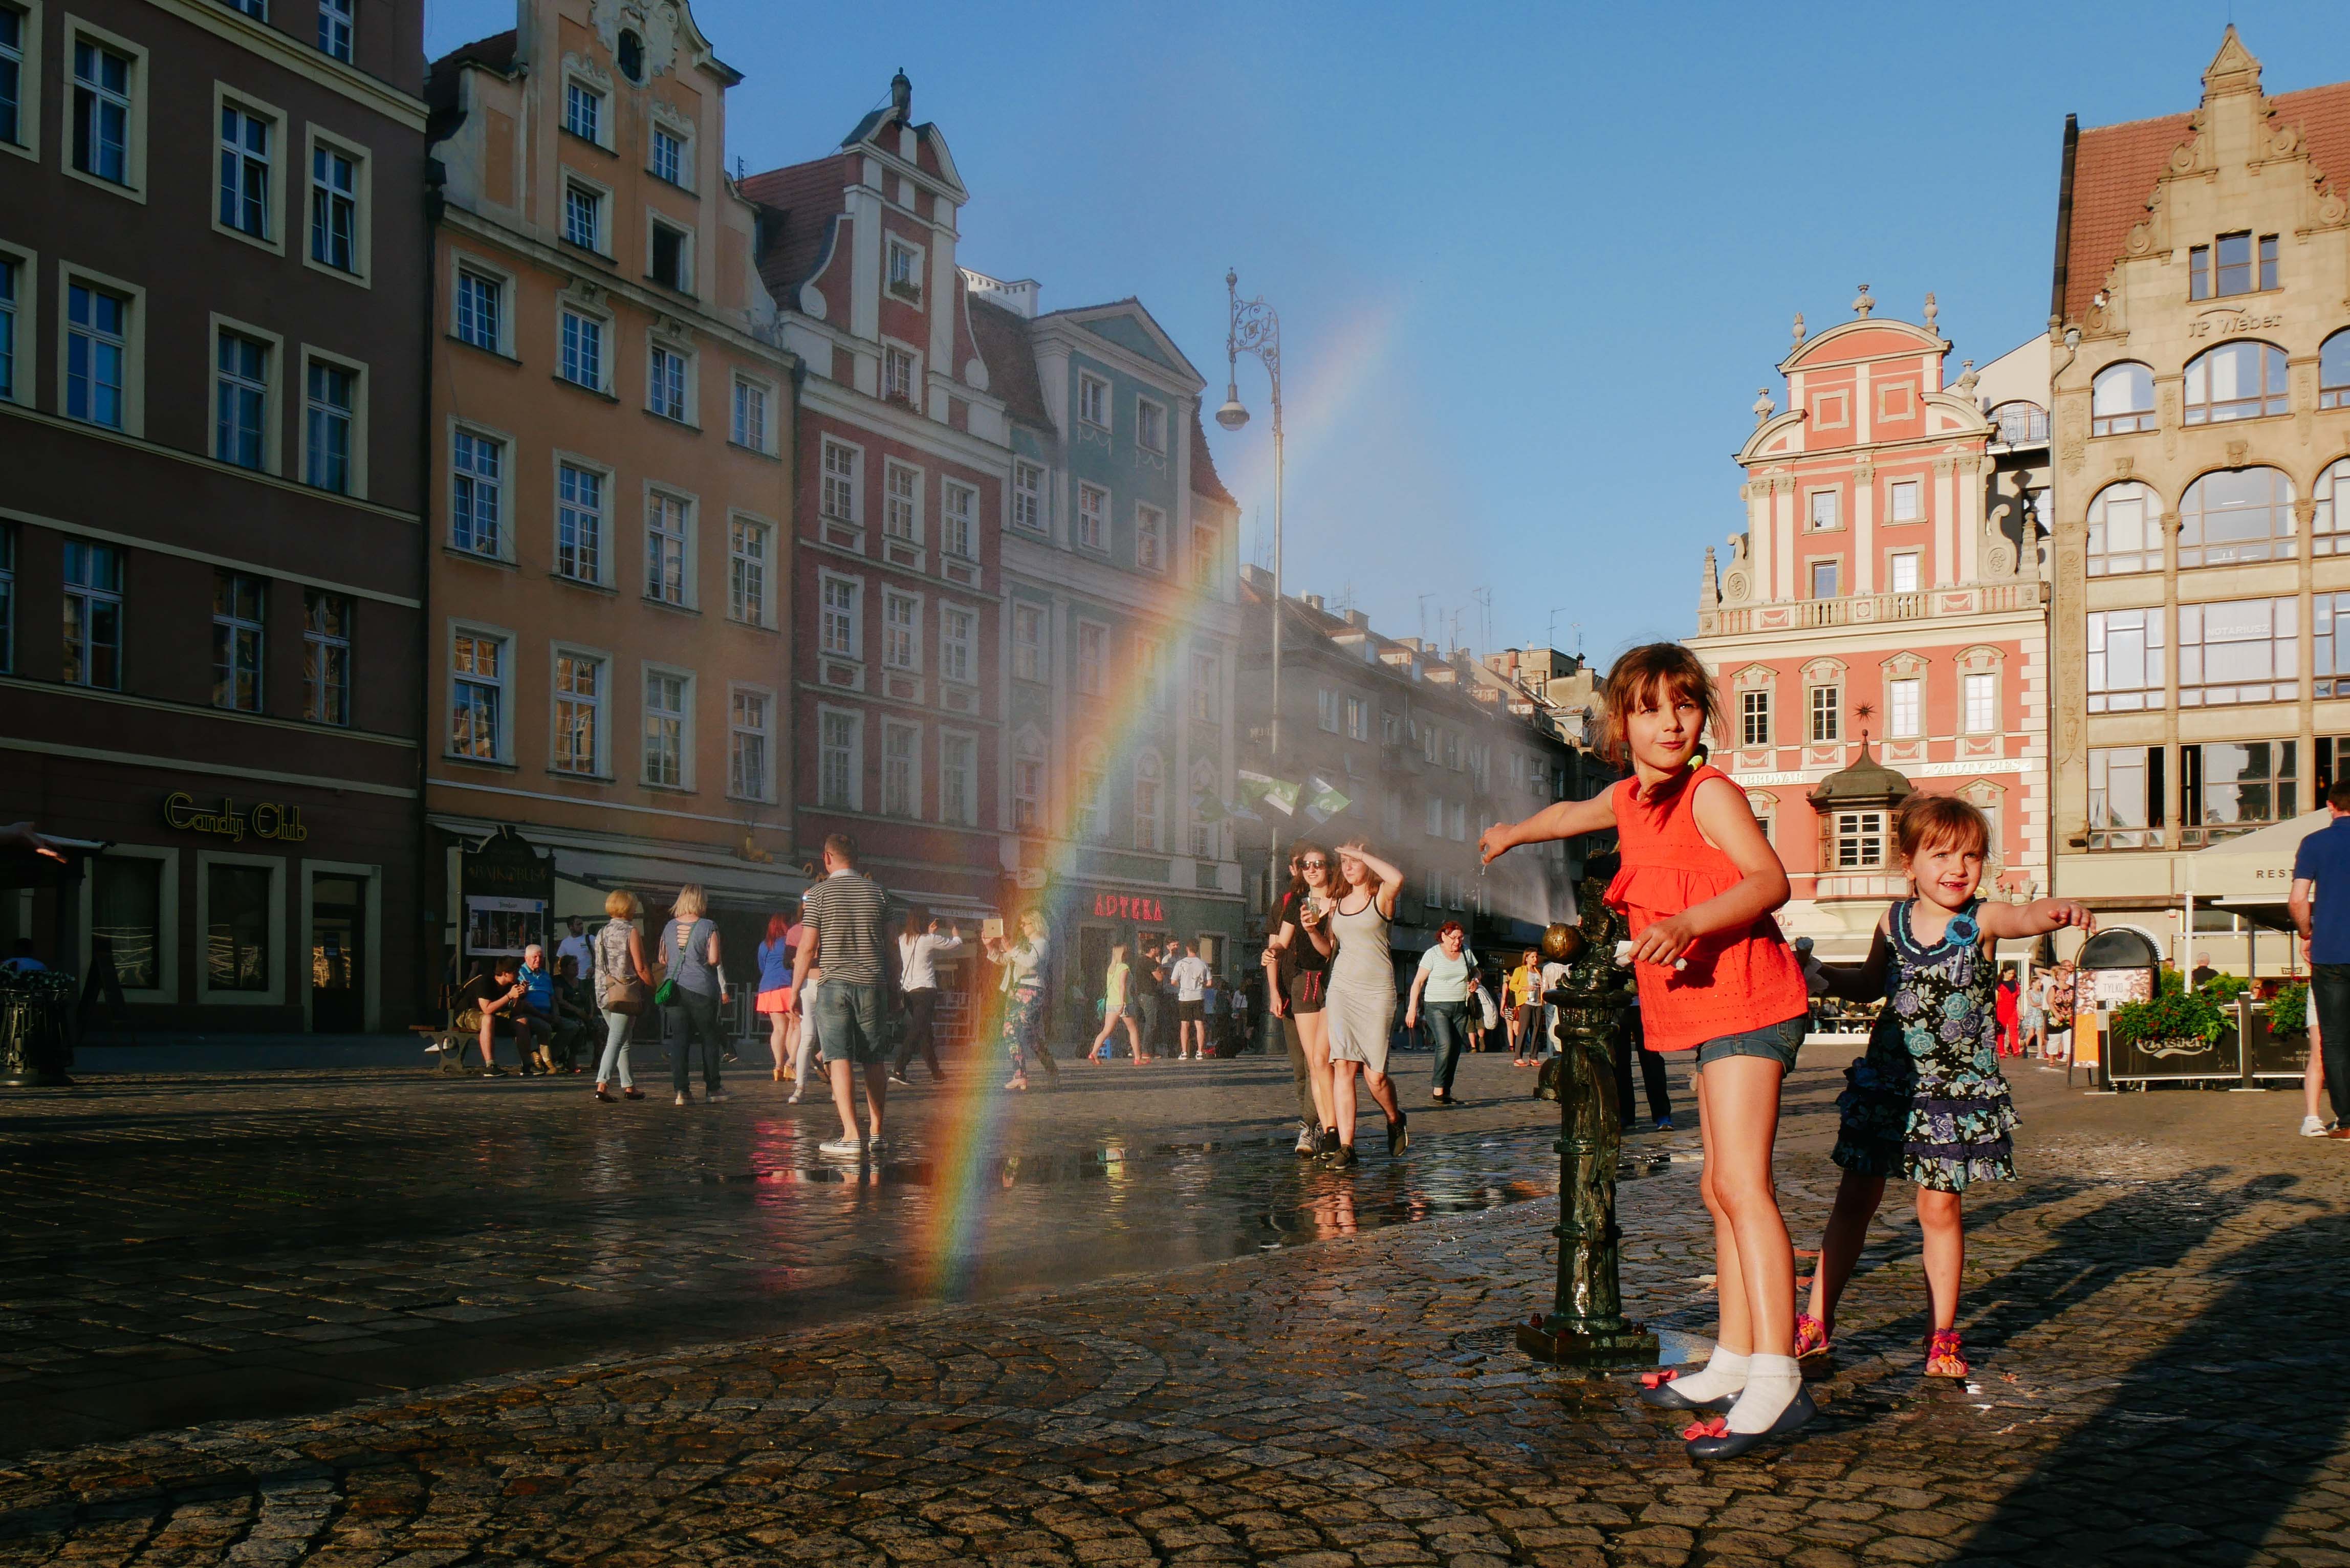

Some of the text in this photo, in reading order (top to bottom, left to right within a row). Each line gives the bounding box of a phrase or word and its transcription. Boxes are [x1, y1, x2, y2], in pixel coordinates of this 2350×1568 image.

[2189, 315, 2282, 338] JP Weber
[1934, 760, 2020, 775] ZŁOTY PIES
[1744, 773, 1805, 785] BROWAR
[164, 791, 307, 843] Candy Club
[1094, 894, 1163, 921] APTEKA
[2103, 983, 2123, 993] TYLKO
